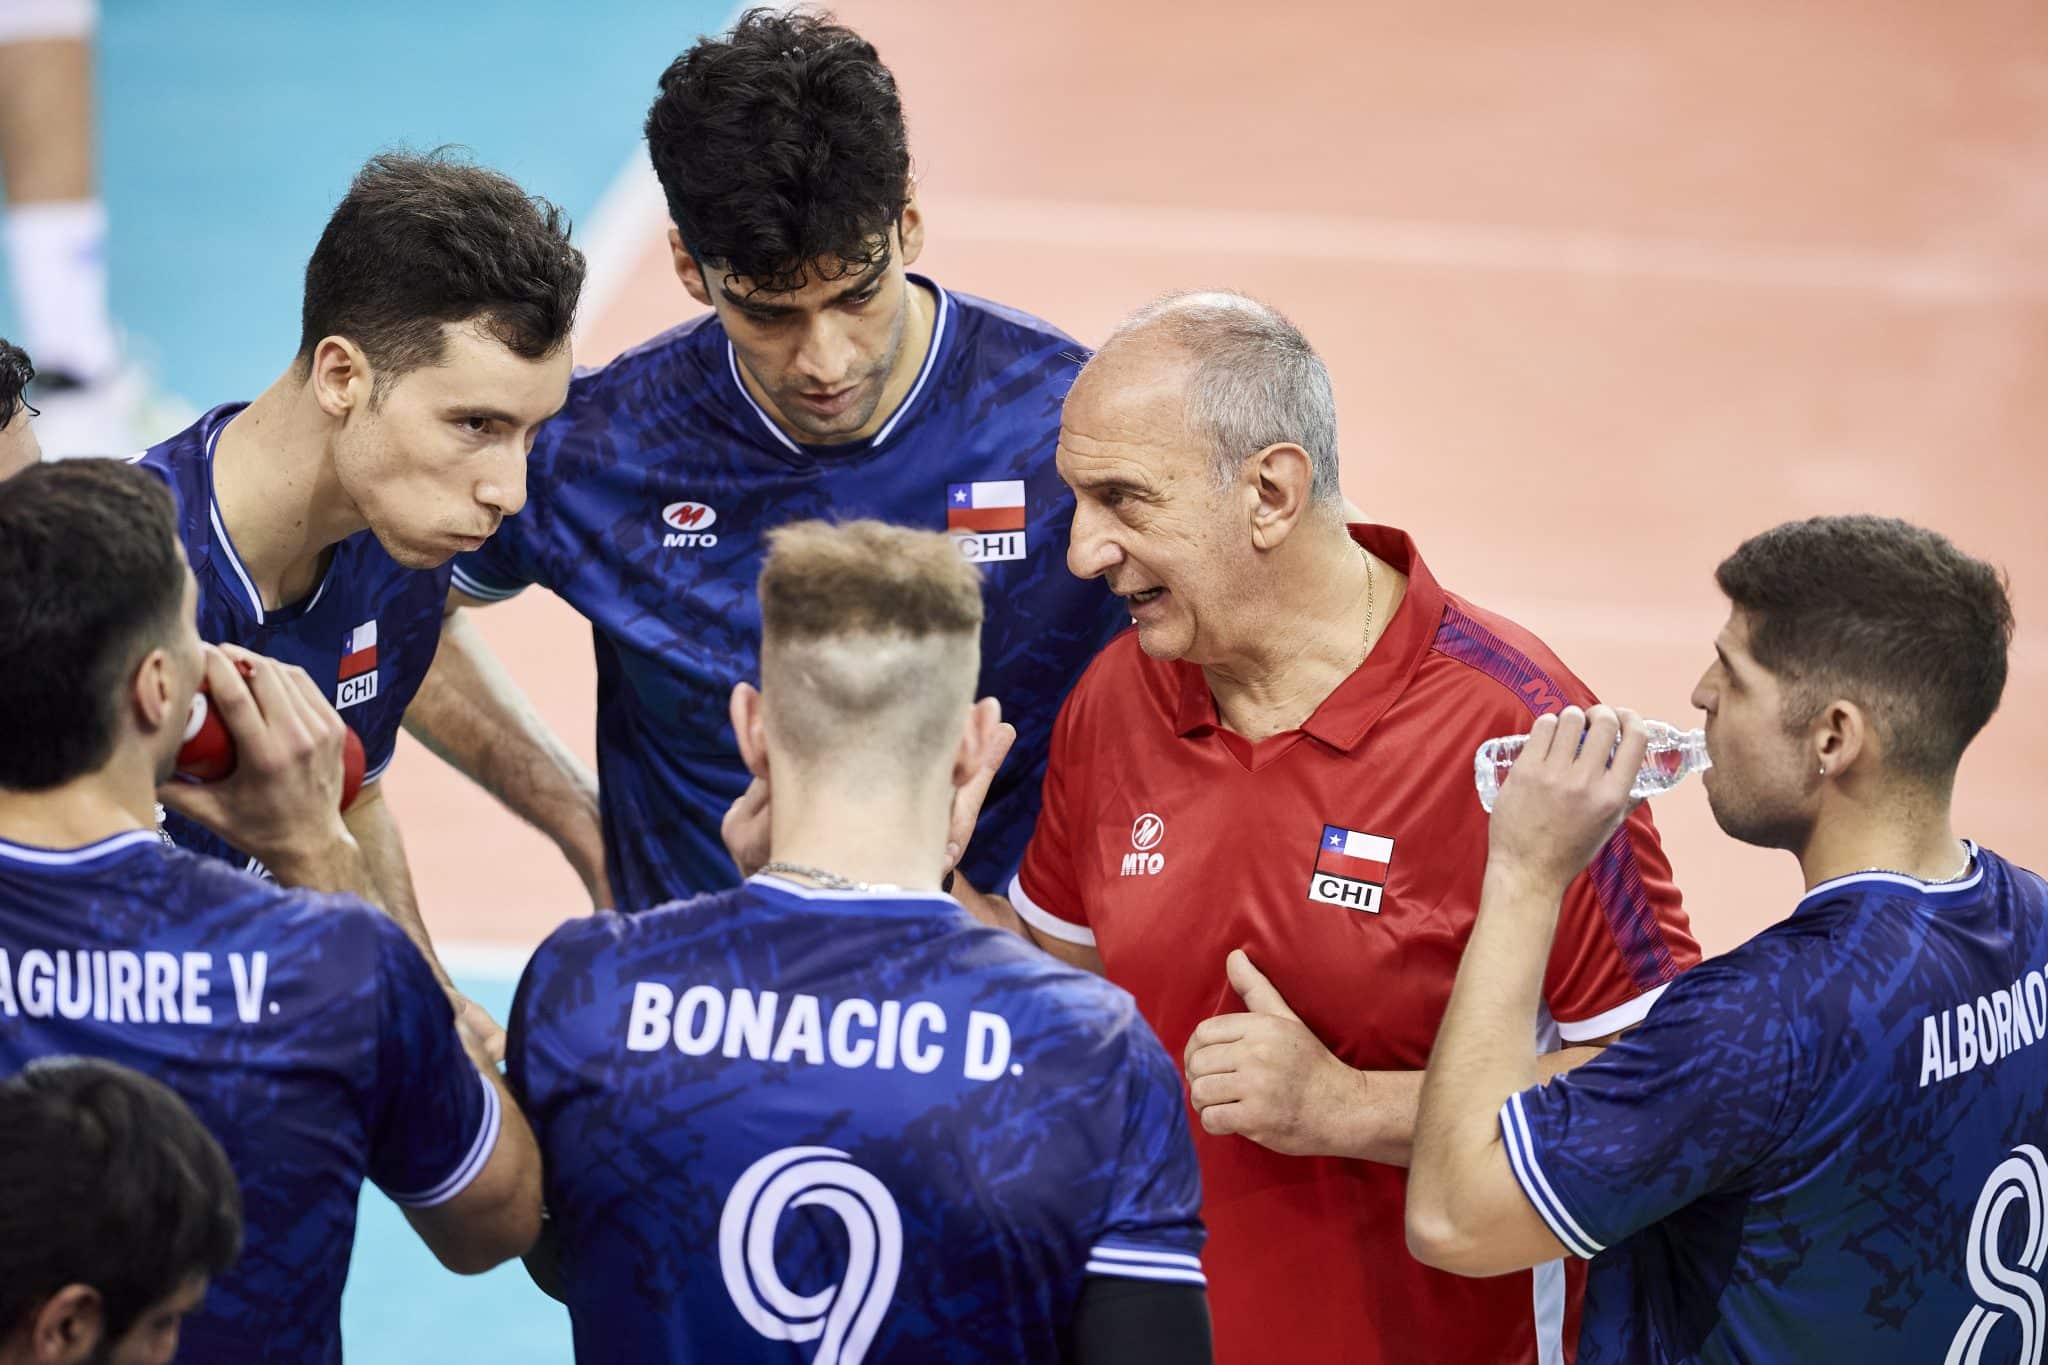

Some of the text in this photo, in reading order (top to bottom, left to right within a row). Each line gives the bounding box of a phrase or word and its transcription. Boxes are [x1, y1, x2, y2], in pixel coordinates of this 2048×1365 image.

[662, 533, 718, 547] MTO
[958, 536, 1015, 558] CHI
[341, 675, 373, 703] CHI
[1120, 852, 1165, 876] MTO
[1319, 879, 1372, 906] CHI
[229, 951, 281, 1024] V.
[625, 981, 1025, 1082] BONACIC D.
[1919, 962, 2048, 1088] ALBORNO
[718, 1145, 902, 1365] 9
[1943, 1143, 2048, 1365] 8
